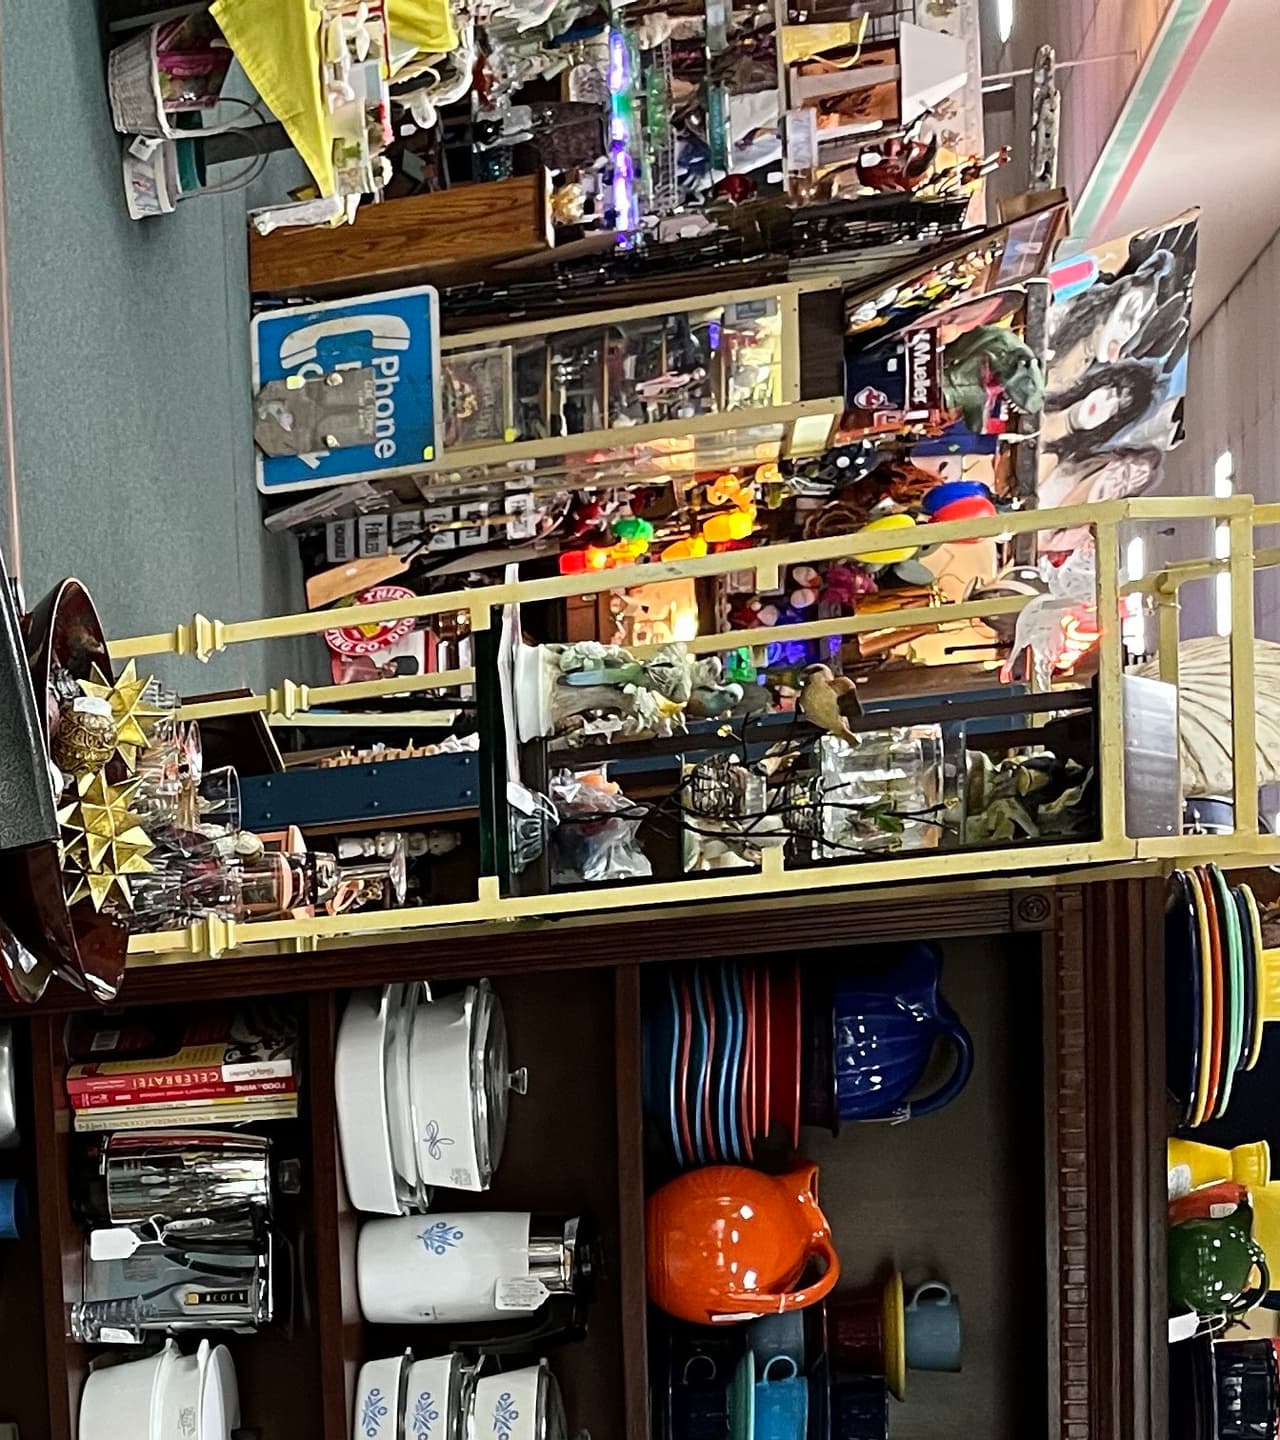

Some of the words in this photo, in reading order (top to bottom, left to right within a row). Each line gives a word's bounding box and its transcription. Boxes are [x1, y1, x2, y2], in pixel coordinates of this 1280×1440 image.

[913, 341, 931, 403] Mueller
[371, 355, 400, 459] Phone
[131, 1071, 219, 1089] CELEBRATE!
